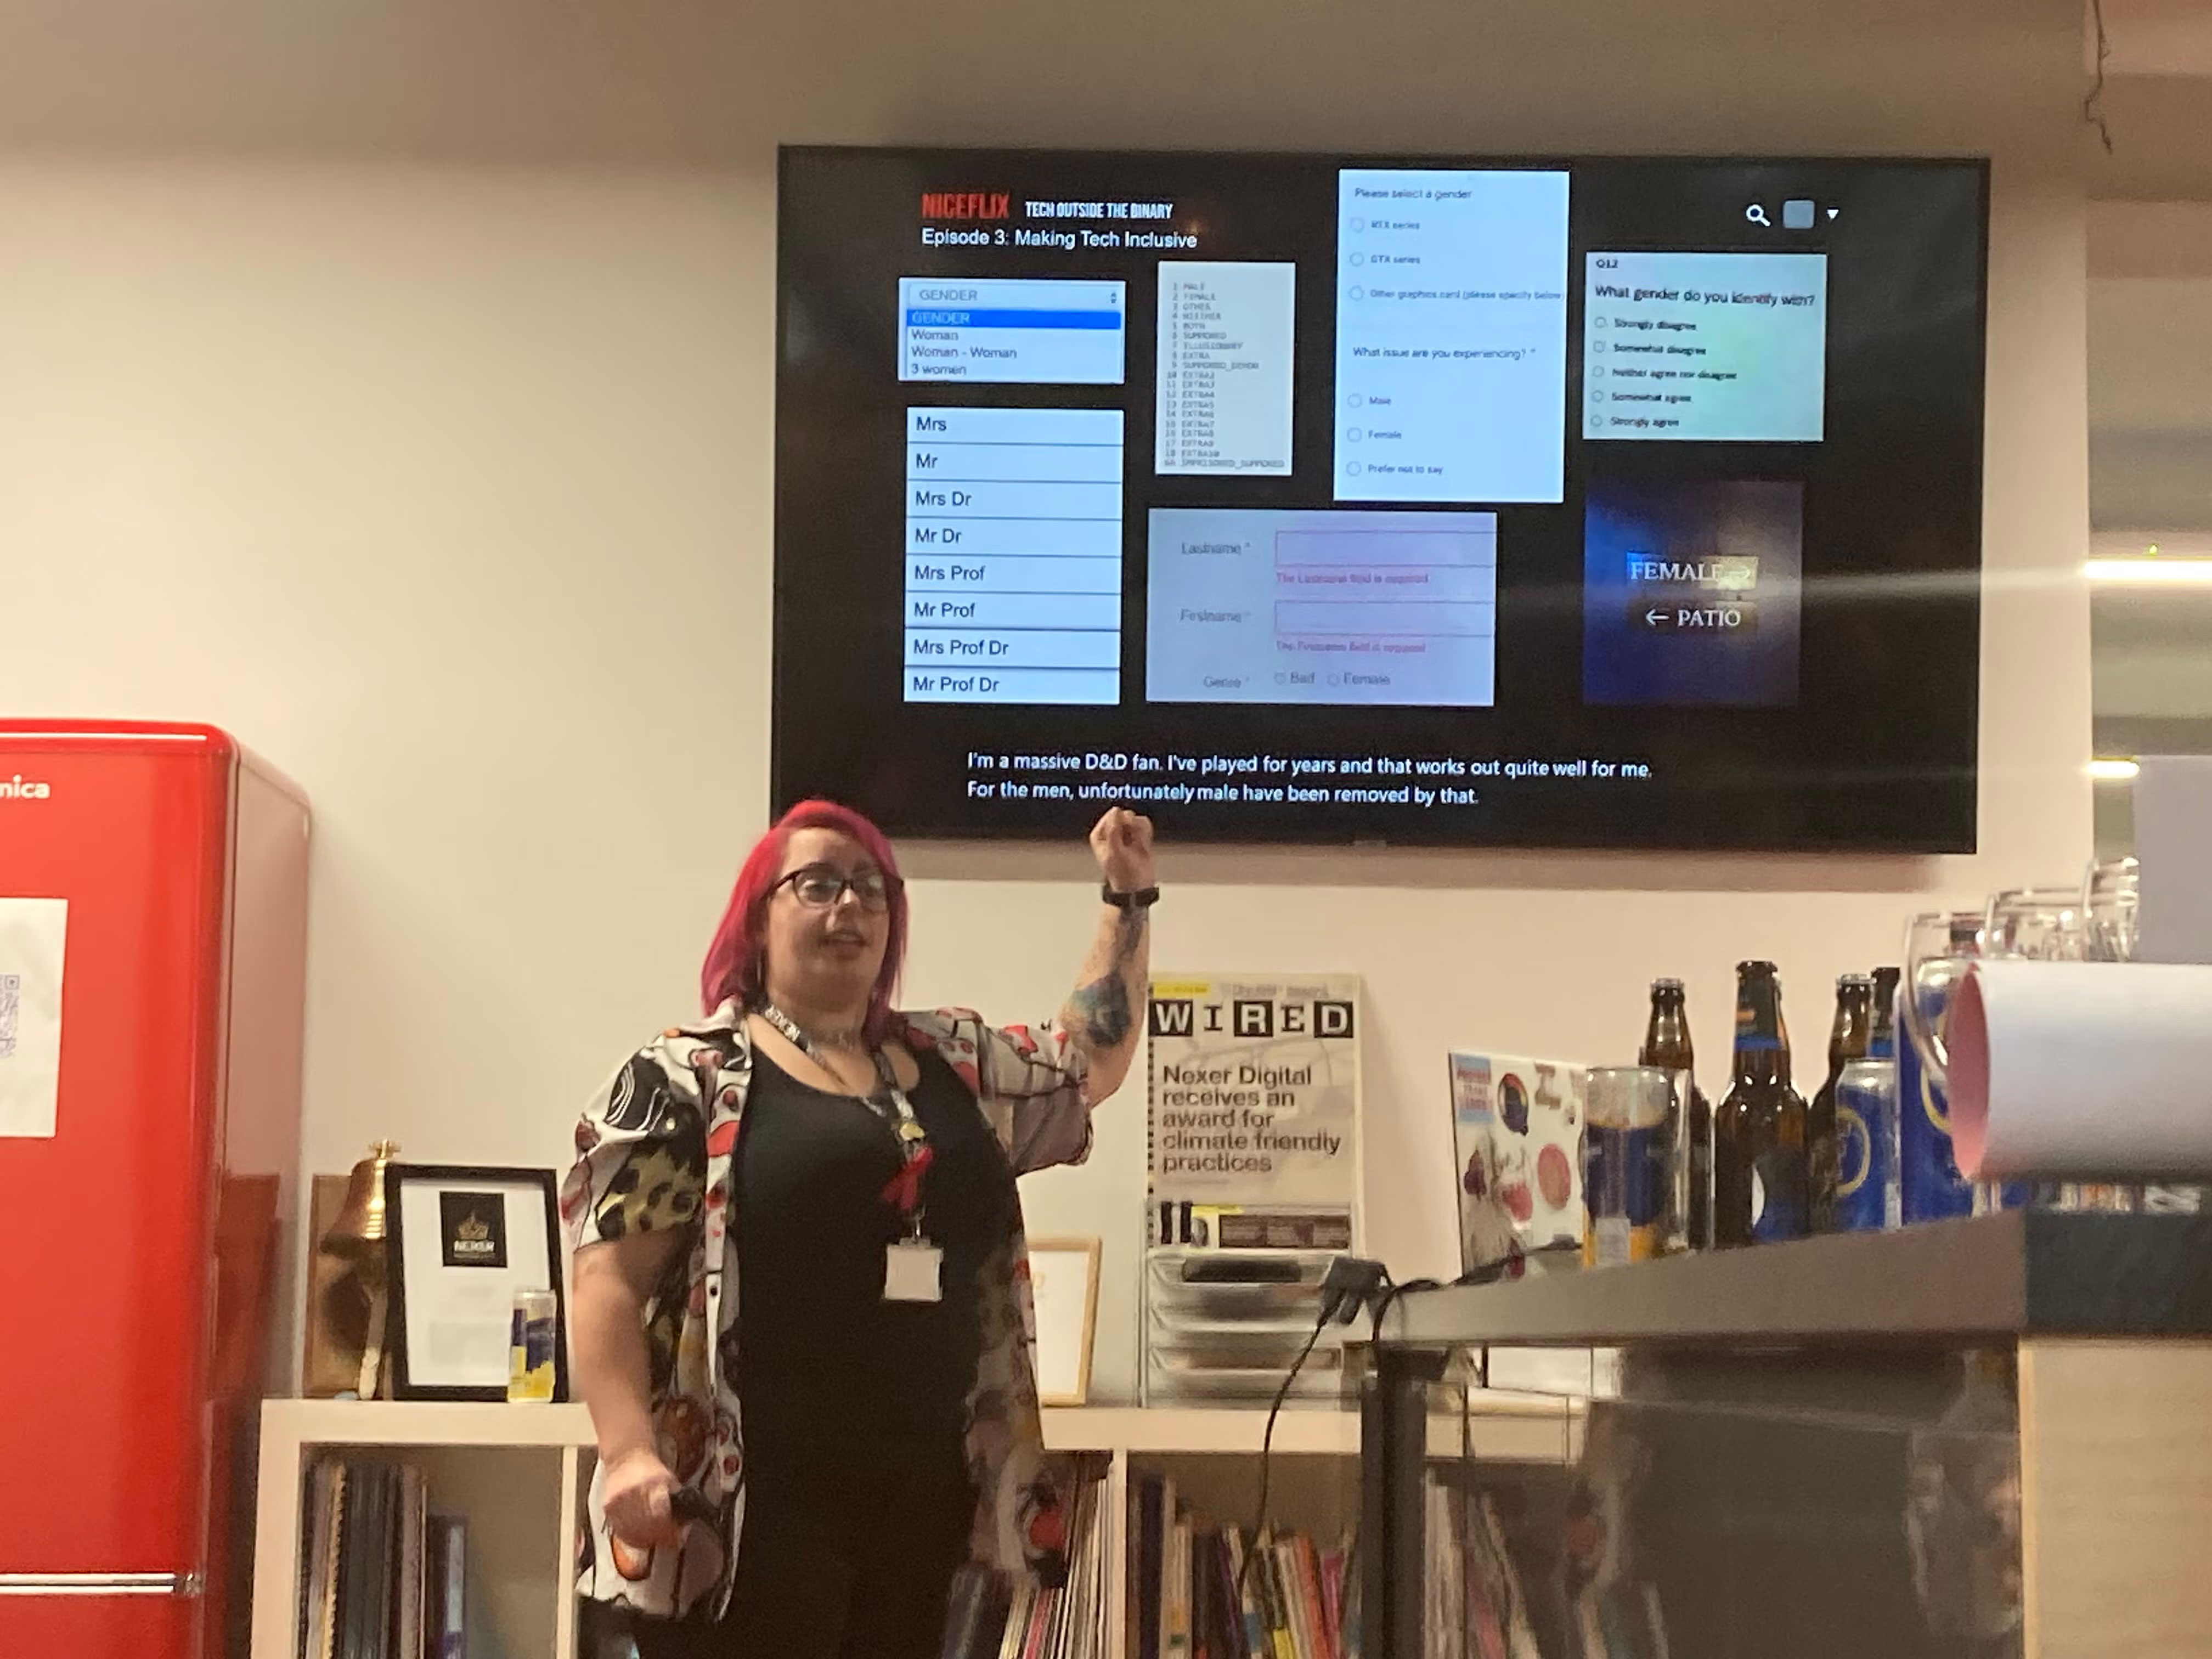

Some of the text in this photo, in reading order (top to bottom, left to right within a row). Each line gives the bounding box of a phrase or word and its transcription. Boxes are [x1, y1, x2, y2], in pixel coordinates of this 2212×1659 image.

[1355, 187, 1472, 201] Please select a gender
[921, 193, 1009, 219] NICEFLIX
[1025, 201, 1173, 219] TECH OUTSIDE THE BINARY
[922, 228, 1198, 250] Episode 3: Making Tech Inclusive
[1370, 254, 1391, 263] GTX
[1595, 259, 1618, 269] Q12
[918, 289, 978, 301] GENDER
[1595, 285, 1629, 298] What
[1633, 288, 1679, 302] gender
[1683, 289, 1701, 302] do
[1704, 292, 1728, 305] you
[1731, 291, 1778, 308] identify
[911, 311, 970, 324] GENDER
[1615, 318, 1654, 331] Strongly
[911, 329, 959, 341] Woman
[911, 345, 1017, 359] Woman Woman
[1353, 347, 1380, 357] What
[1383, 349, 1409, 358] issue
[1412, 349, 1429, 358] are
[1432, 350, 1451, 360] you
[911, 363, 967, 375] 3 women
[1650, 371, 1677, 380] agree
[1369, 396, 1392, 405] Male
[1664, 395, 1692, 404] agree
[916, 416, 947, 432] Mrs
[1610, 416, 1679, 428] Strongly agree
[1368, 430, 1402, 439] Female
[916, 453, 938, 469] Mr
[1368, 464, 1396, 473] Prefer
[1415, 466, 1425, 474] to
[1427, 466, 1443, 475] say
[916, 490, 972, 506] Mrs Dr
[915, 527, 962, 543] Mr Dr
[915, 565, 986, 581] Mrs Prof
[914, 602, 975, 618] Mr Prof
[1677, 608, 1742, 627] PATIO
[913, 639, 1009, 656] Mrs Prof Dr
[913, 676, 1000, 692] Mr Prof Dr
[1290, 671, 1316, 684] Bad
[1343, 672, 1391, 685] Female
[968, 752, 1652, 780] I'm a massive D&D fan. I've played for years and that works out quite well for me.
[967, 780, 1479, 808] For the men, unfortunately male have been removed by that.
[1148, 1000, 1353, 1039] WIRED
[1163, 1065, 1311, 1089] Nexer Digital
[1163, 1089, 1295, 1107] receives an
[1163, 1109, 1274, 1128] award for
[1163, 1130, 1341, 1156] climate friendly
[1163, 1154, 1272, 1175] practices
